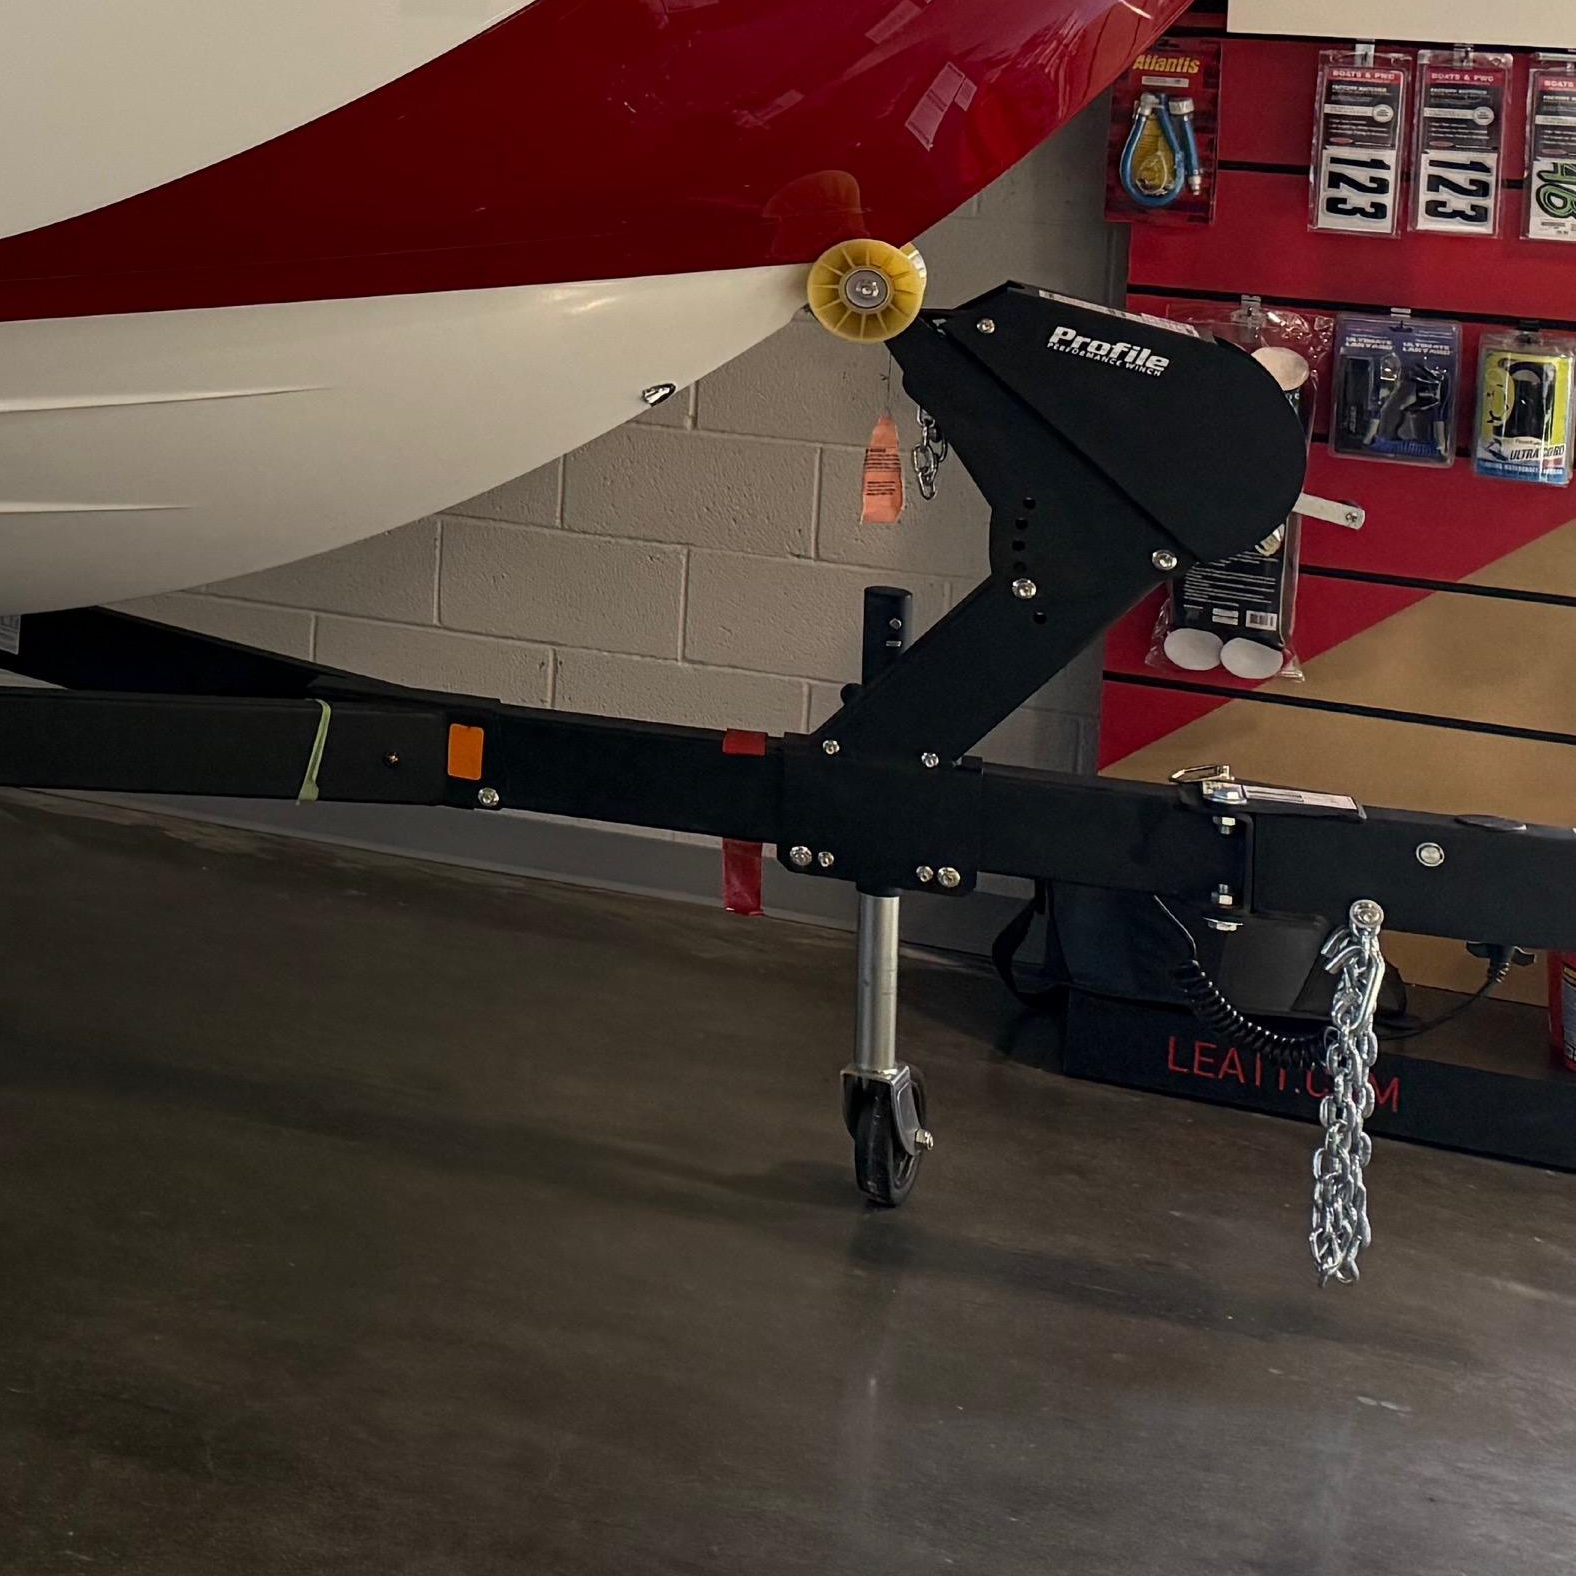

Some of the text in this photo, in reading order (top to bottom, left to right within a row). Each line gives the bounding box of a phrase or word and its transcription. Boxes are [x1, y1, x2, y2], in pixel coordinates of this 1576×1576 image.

[1132, 54, 1201, 74] Atlantis
[1332, 70, 1362, 78] BOATS
[1431, 72, 1460, 80] BOATS
[1049, 326, 1170, 371] Profile
[1047, 342, 1162, 377] PERFORMANCE WINCH
[1509, 448, 1539, 460] ULTRA
